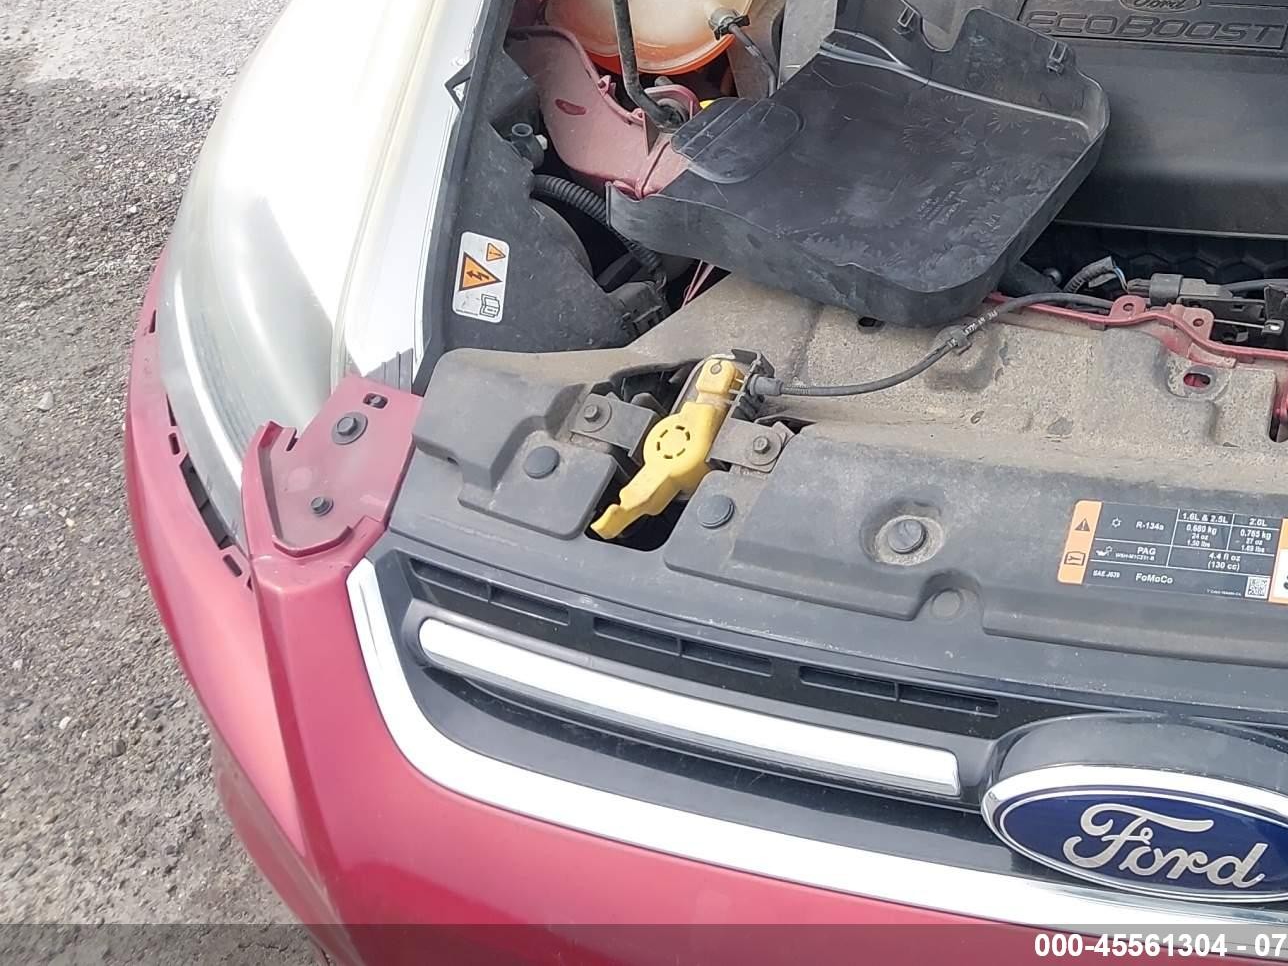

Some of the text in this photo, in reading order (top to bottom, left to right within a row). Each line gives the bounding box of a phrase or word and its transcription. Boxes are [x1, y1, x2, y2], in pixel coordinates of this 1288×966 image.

[1182, 512, 1229, 524] 1.6L & 2.5L
[1135, 521, 1165, 531] R-134a
[1207, 526, 1217, 536] kg
[1240, 528, 1272, 541] 0.765 kg
[1201, 540, 1211, 548] lbs
[1137, 546, 1157, 556] PAG
[1208, 552, 1222, 560] 4.4
[1207, 561, 1240, 572] (130 cc)
[1135, 573, 1174, 584] FoMoCo
[1062, 802, 1268, 890] Ford
